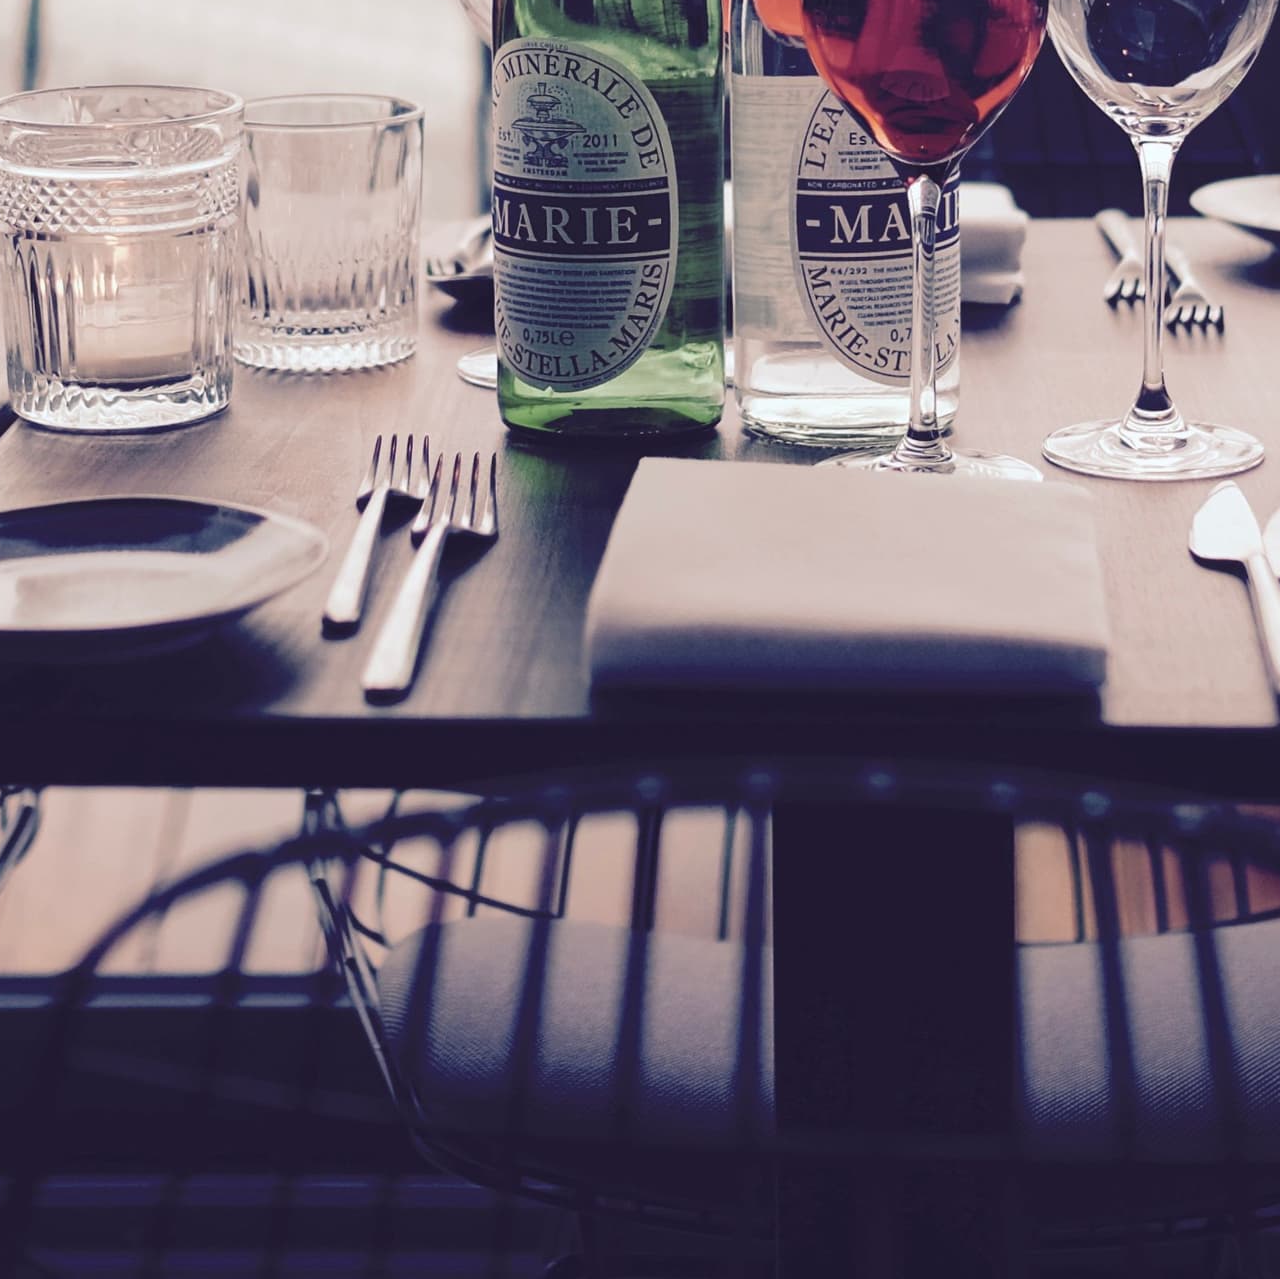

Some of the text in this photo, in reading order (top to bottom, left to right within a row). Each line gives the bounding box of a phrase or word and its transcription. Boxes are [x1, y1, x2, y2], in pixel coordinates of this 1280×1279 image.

[502, 48, 640, 120] MINÉRALE
[631, 123, 660, 169] DE
[583, 134, 618, 148] 2011
[523, 167, 568, 177] AMSTERDAM
[827, 180, 877, 191] CARBONATED
